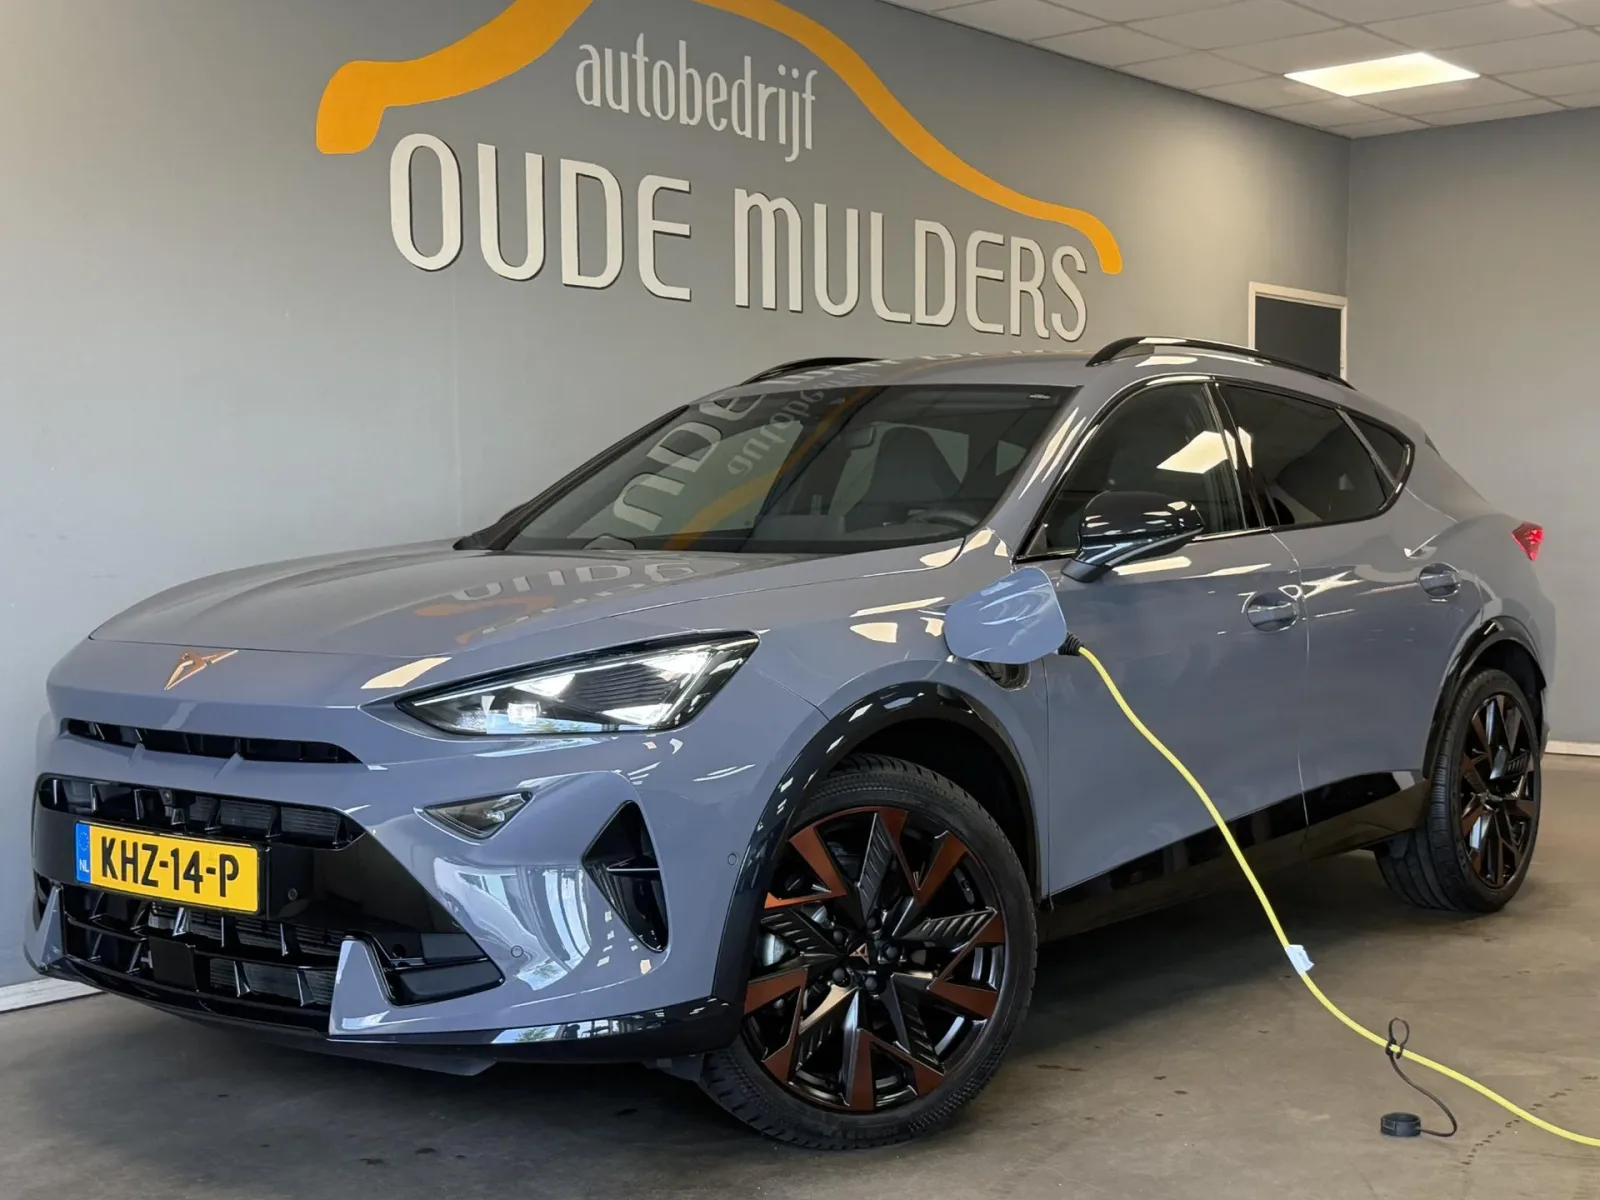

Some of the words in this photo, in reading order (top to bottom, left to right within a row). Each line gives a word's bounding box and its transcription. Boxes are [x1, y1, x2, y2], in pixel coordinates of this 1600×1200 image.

[576, 33, 817, 162] autobedrijf
[390, 134, 691, 302] OUDE
[79, 860, 89, 872] NL
[101, 836, 239, 897] KHZ-14-P
